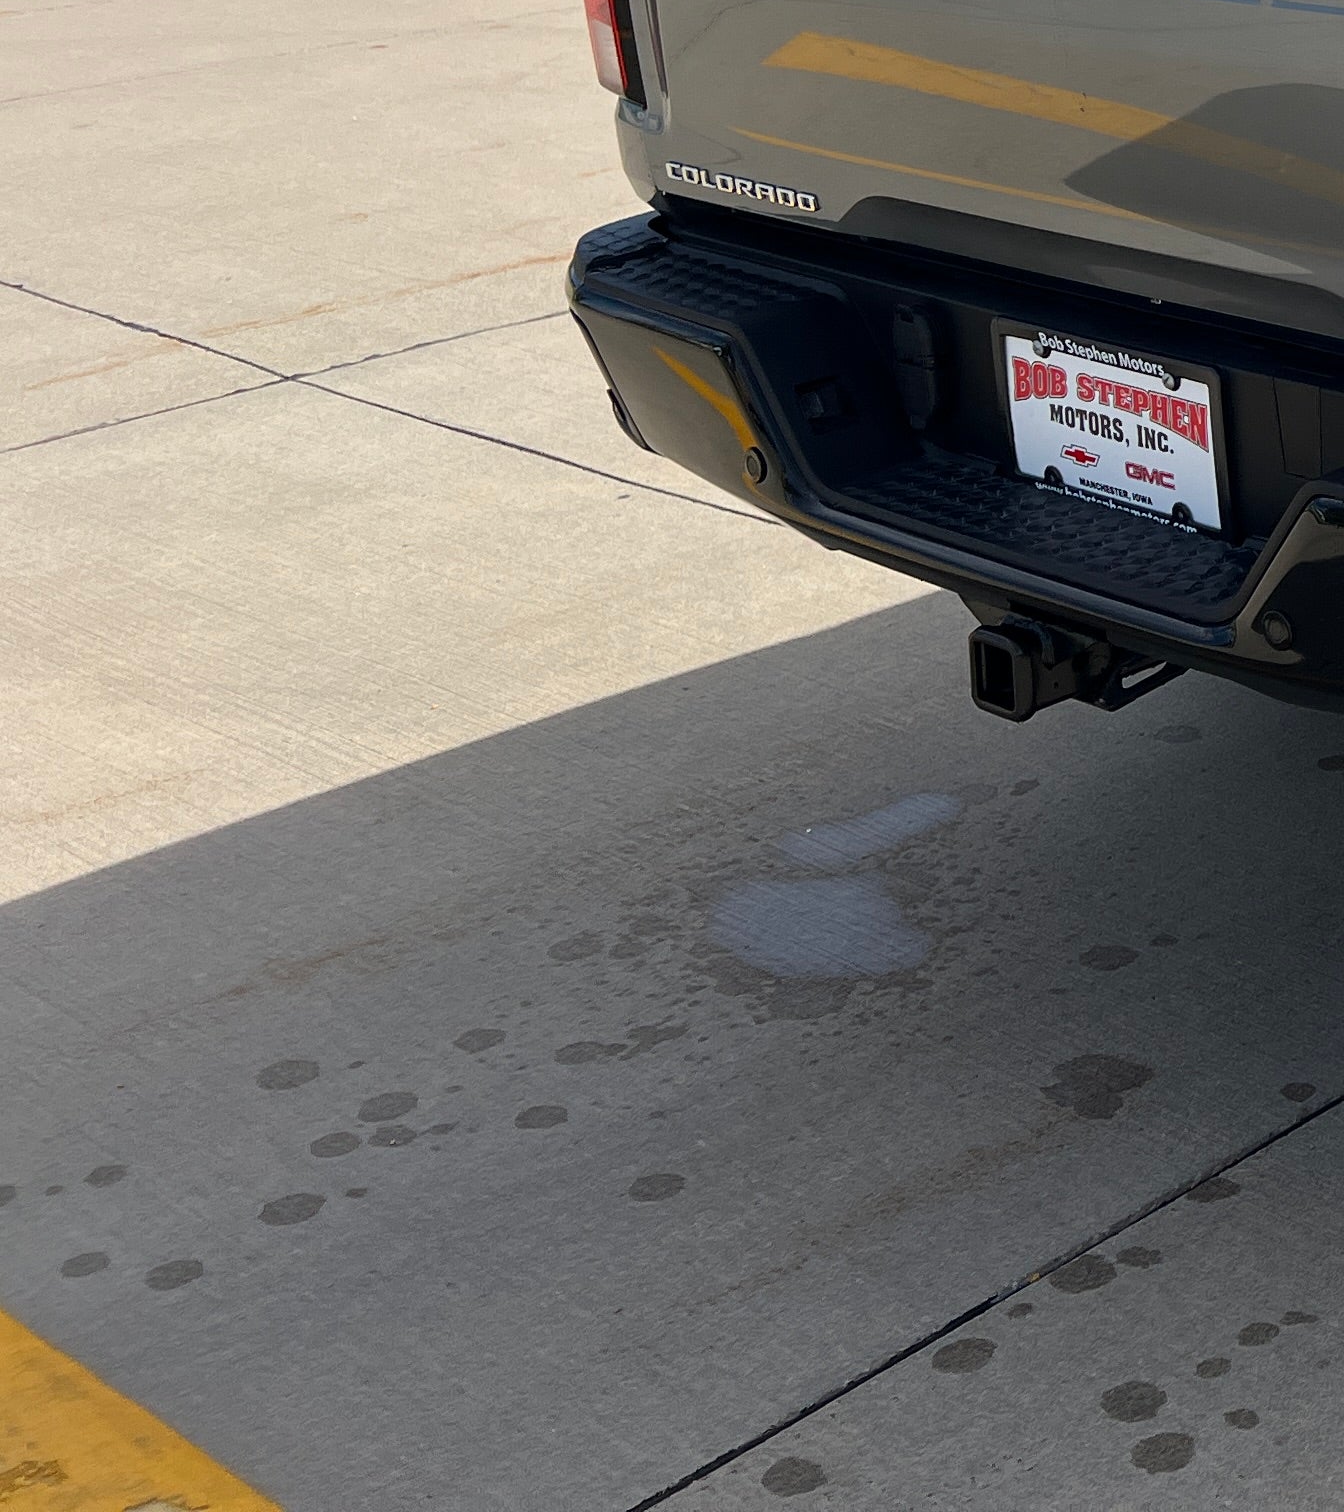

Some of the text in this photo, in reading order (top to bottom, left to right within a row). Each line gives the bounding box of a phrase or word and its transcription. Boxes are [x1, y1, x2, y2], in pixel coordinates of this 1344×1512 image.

[665, 161, 820, 213] COLORADO
[1038, 331, 1165, 377] Bob Stephen Motors
[1012, 356, 1209, 453] BOB STEPHEN
[1049, 403, 1175, 454] MOTORS, INC.
[1079, 477, 1154, 506] MANCHESTER, IOWA
[1124, 460, 1176, 491] GMC
[1035, 481, 1198, 534] wwwbobstephenmotorscom
